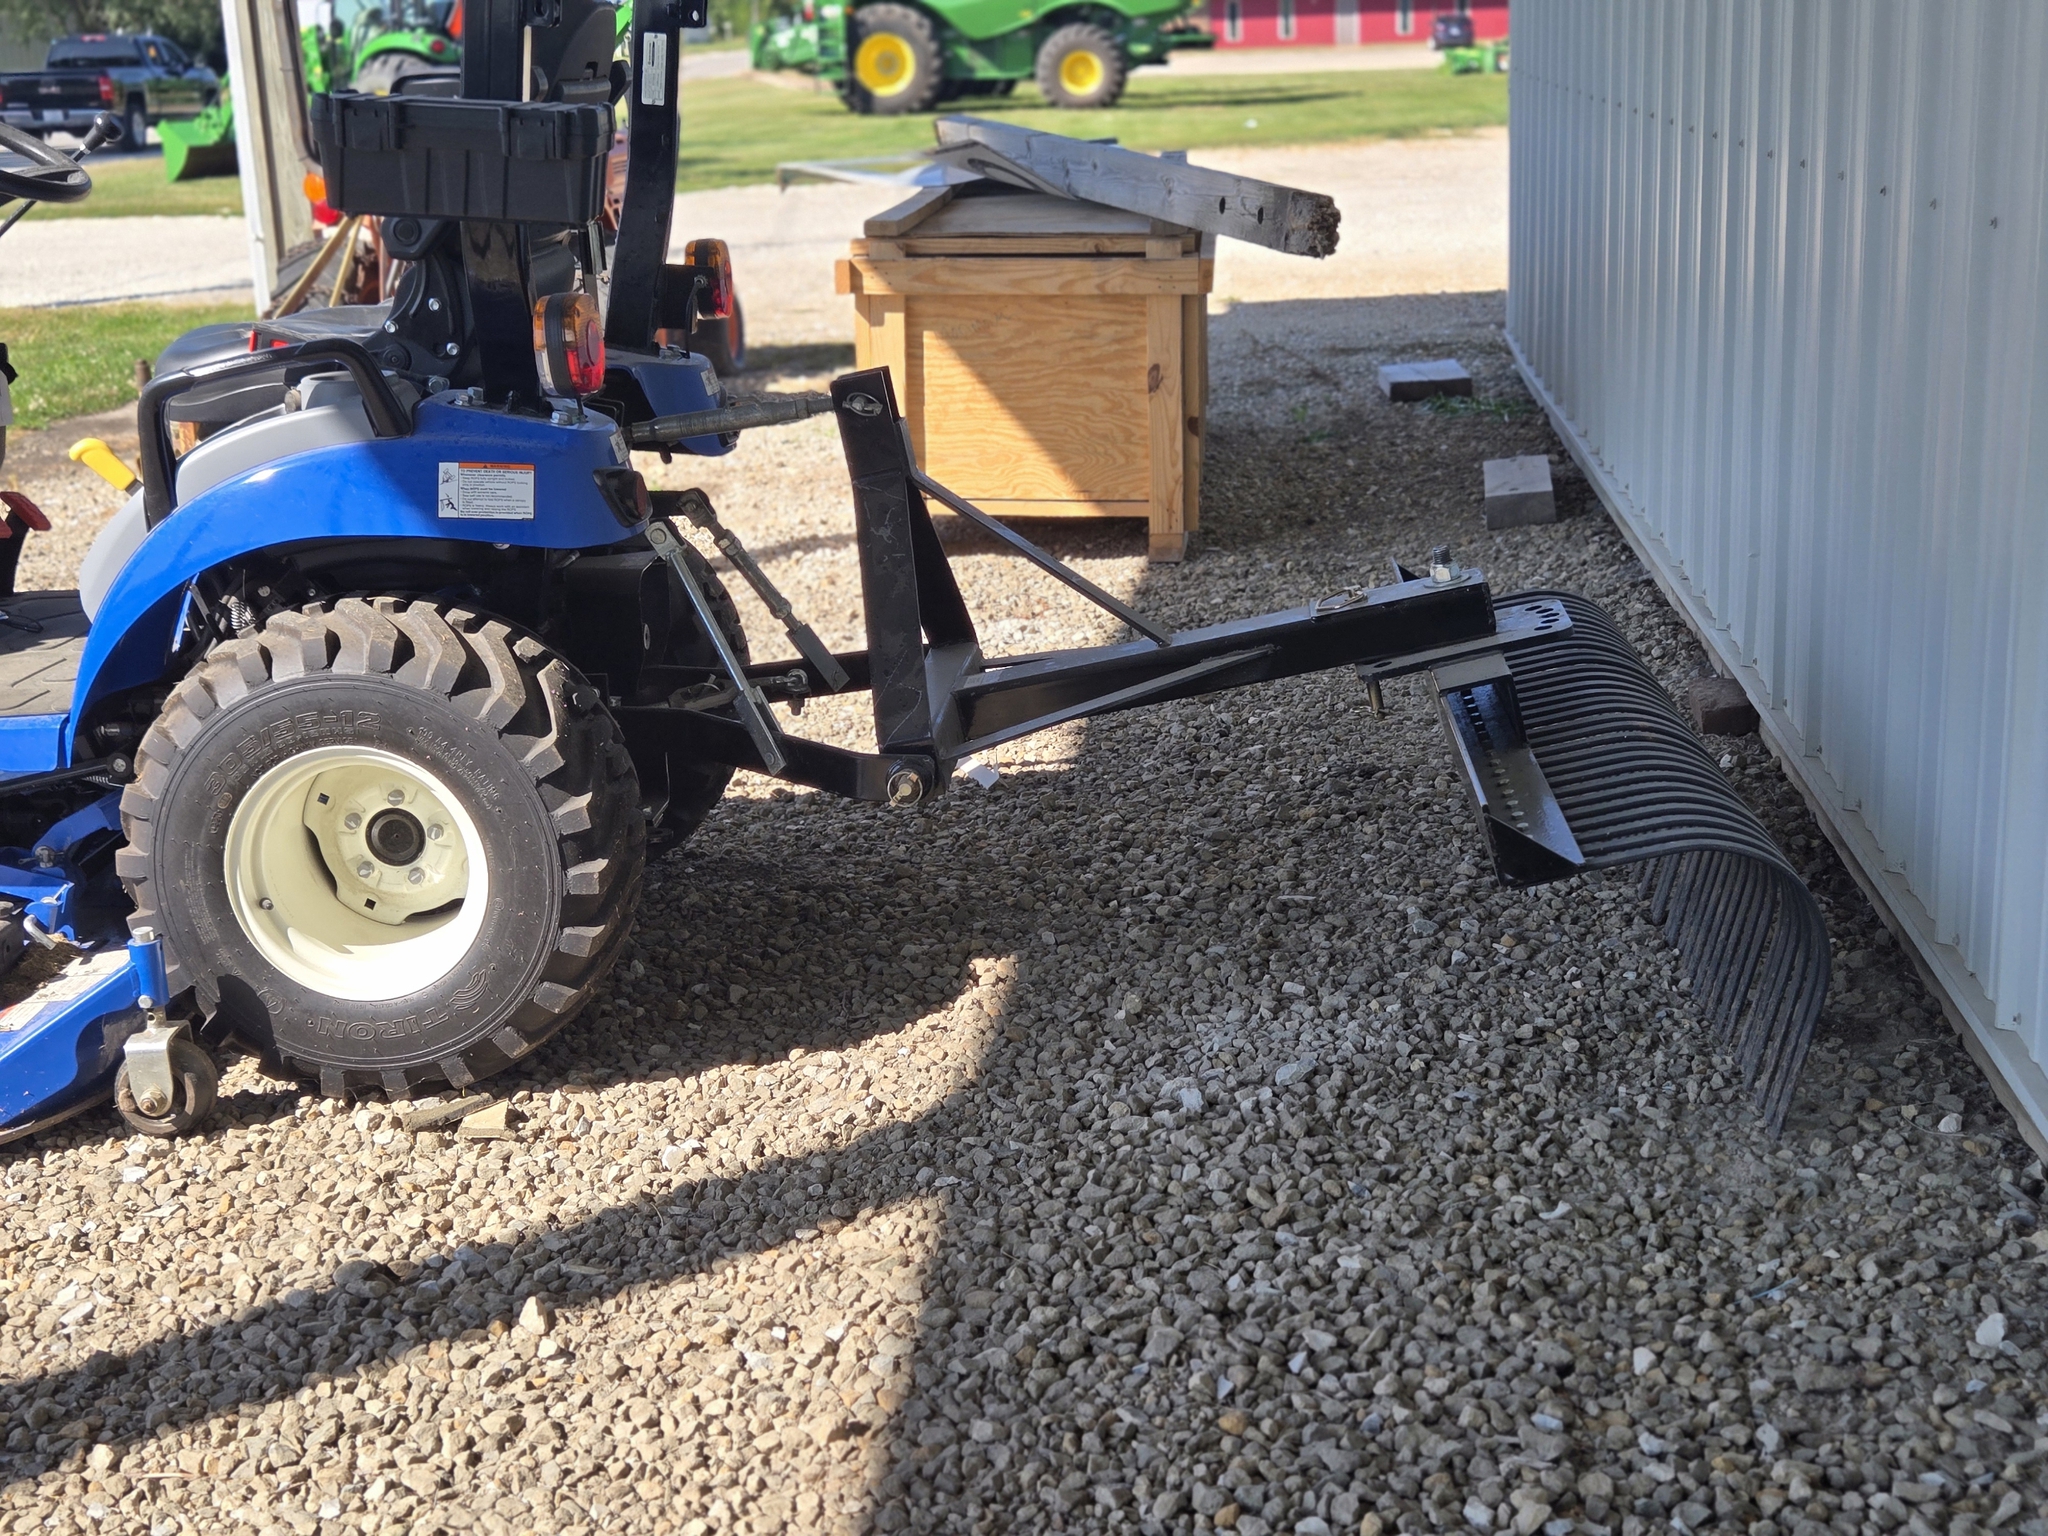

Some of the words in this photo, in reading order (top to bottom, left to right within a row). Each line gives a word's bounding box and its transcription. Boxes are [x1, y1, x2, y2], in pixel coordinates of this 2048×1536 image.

[204, 710, 382, 795] 305/55-12
[473, 766, 501, 801] RATING
[317, 1007, 450, 1040] TIRON
